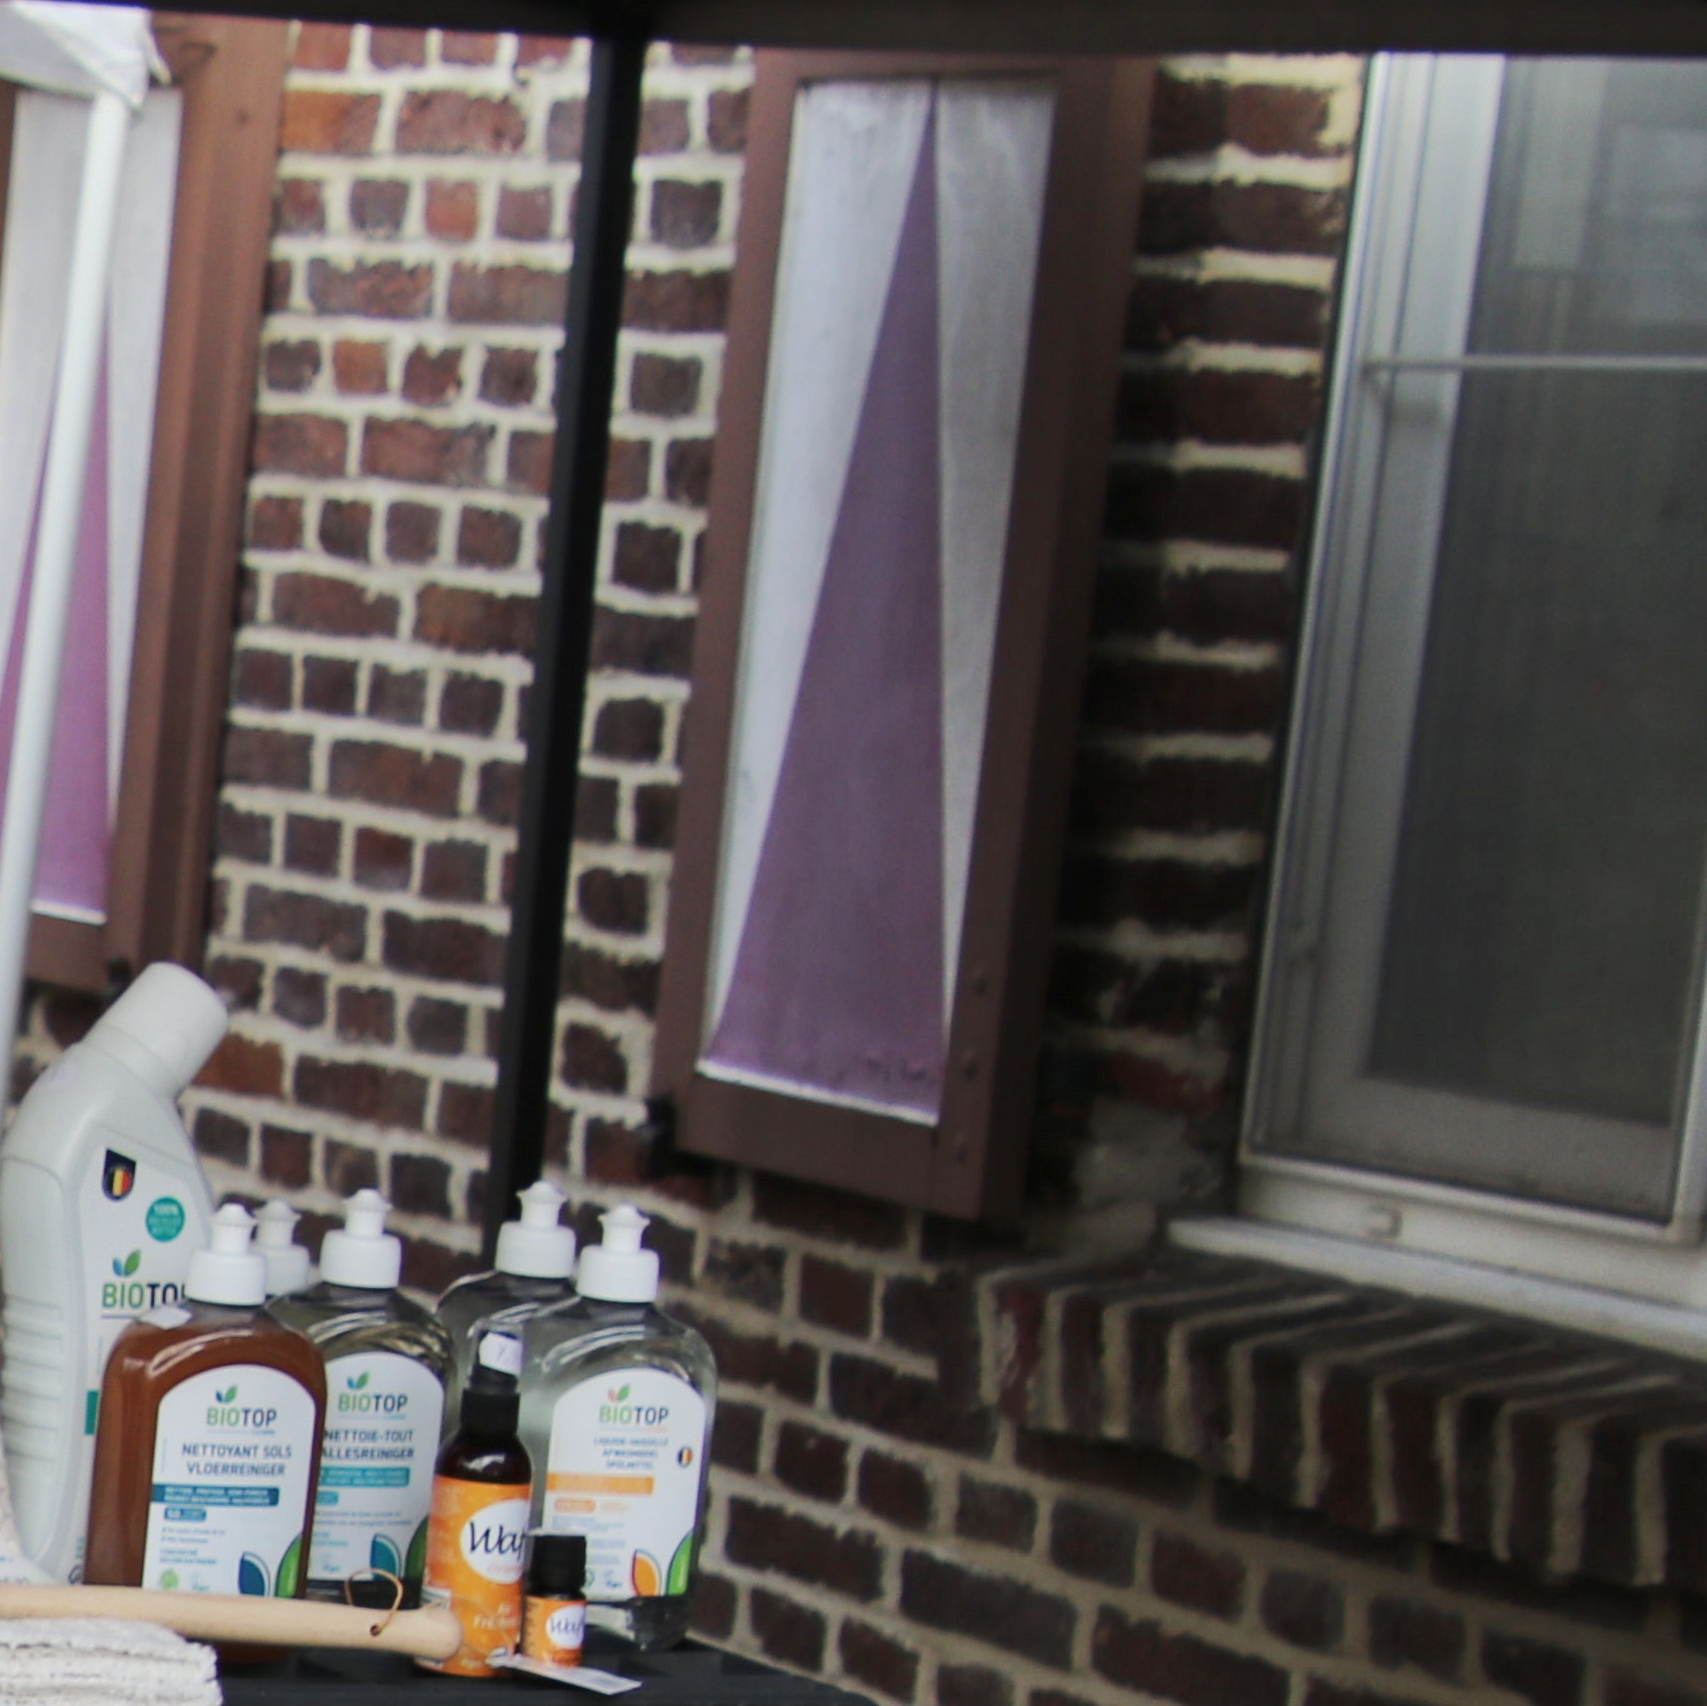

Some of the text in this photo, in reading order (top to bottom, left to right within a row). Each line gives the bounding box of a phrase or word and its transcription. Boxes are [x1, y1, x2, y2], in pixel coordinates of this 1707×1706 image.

[102, 1283, 187, 1309] BIOTO
[338, 1394, 407, 1412] BIOTOP
[207, 1406, 277, 1427] BIOTOP
[599, 1405, 669, 1425] BIOTOP
[182, 1442, 292, 1460] NETTOYANT SOLS
[187, 1461, 285, 1476] VLOERREINIGER
[469, 1519, 529, 1561] Waf
